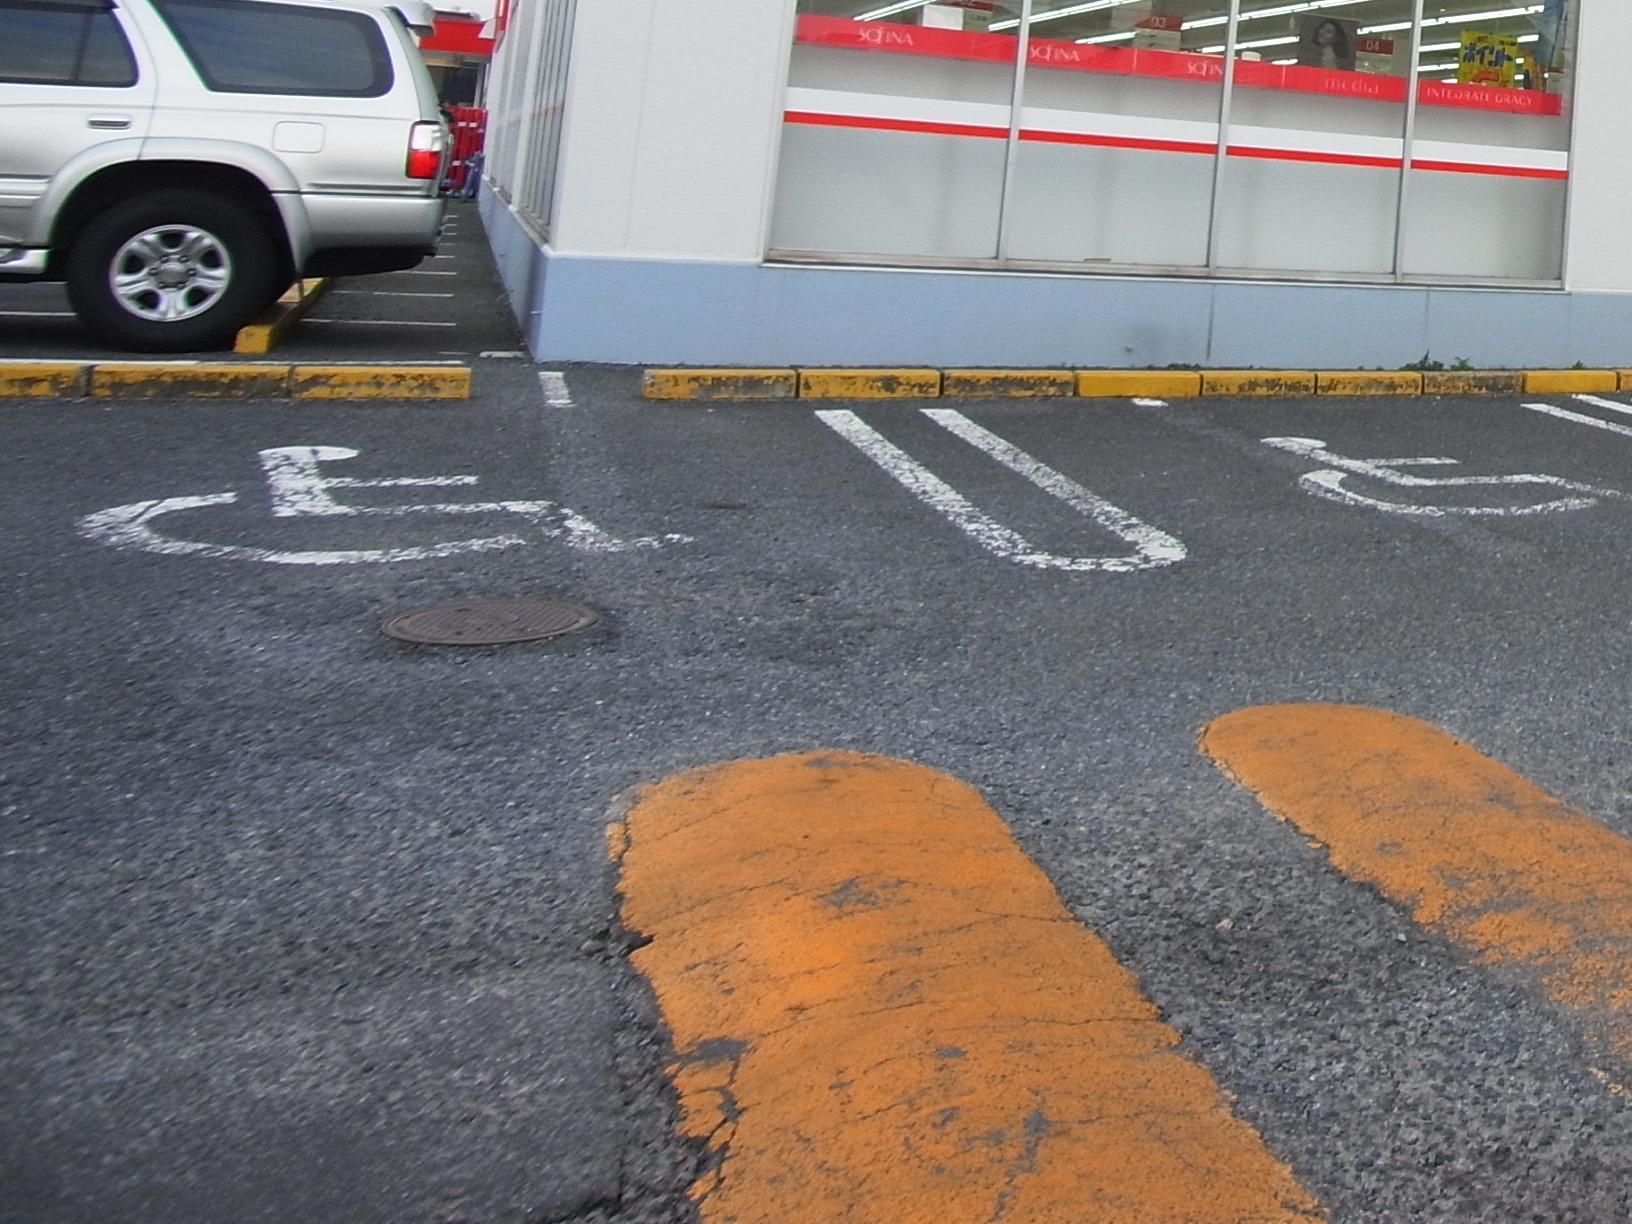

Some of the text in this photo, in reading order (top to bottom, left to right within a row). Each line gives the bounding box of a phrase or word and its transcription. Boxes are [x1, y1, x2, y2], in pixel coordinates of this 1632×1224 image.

[1151, 16, 1167, 28] 03
[858, 27, 914, 46] SOFINA
[1366, 40, 1380, 50] 04
[1029, 43, 1080, 62] SOFINA
[1187, 59, 1225, 77] SOFIN
